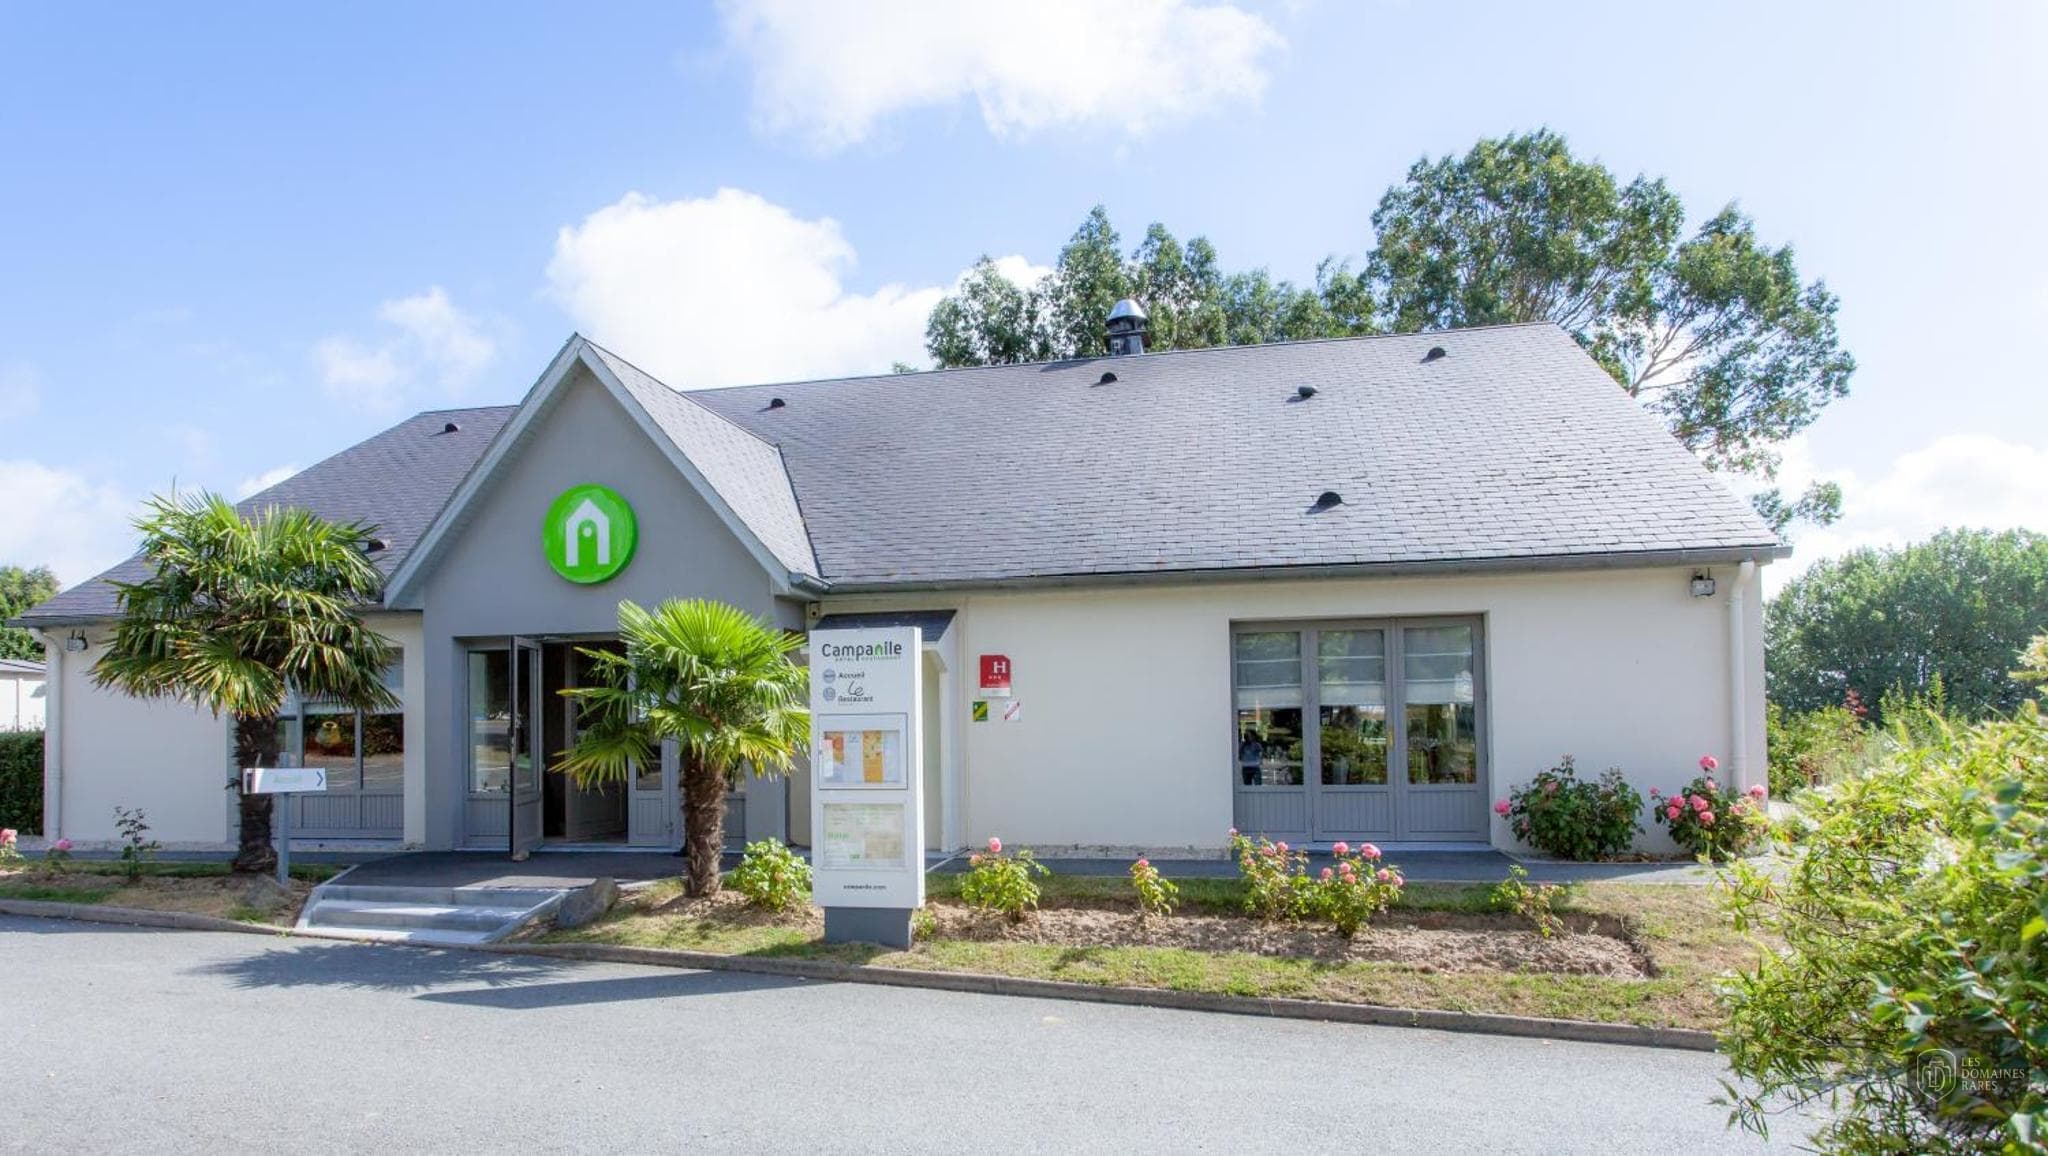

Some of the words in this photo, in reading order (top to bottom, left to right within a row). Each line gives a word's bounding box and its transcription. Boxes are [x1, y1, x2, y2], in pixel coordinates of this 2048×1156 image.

[821, 641, 902, 661] Campanile
[993, 661, 1006, 674] H
[839, 671, 865, 679] Accueil
